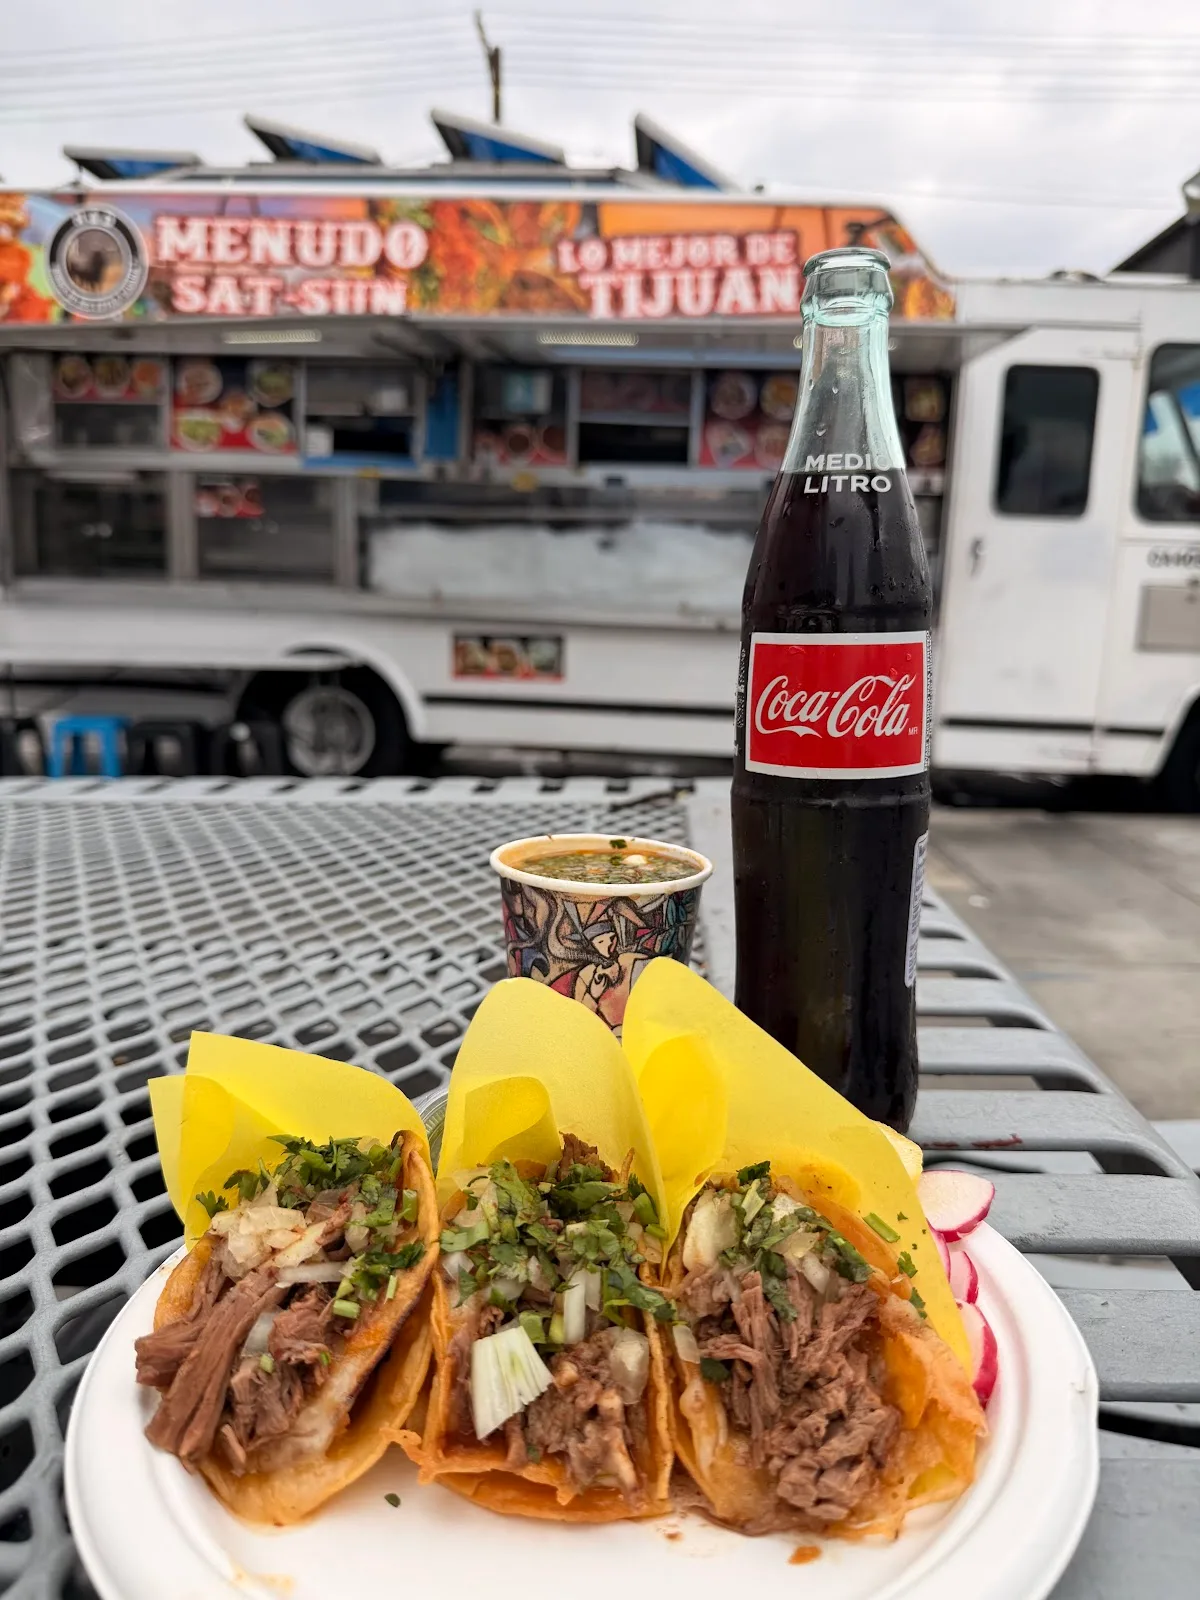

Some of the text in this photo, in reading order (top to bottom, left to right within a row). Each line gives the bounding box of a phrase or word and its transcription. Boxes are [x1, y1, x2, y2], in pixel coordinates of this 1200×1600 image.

[157, 216, 429, 269] MENUDO
[557, 231, 797, 273] LO MEJOR DE
[579, 266, 801, 319] TIJUAN
[803, 475, 892, 494] LITRO
[804, 453, 893, 472] MEDIO
[755, 674, 916, 739] Coca-Cola
